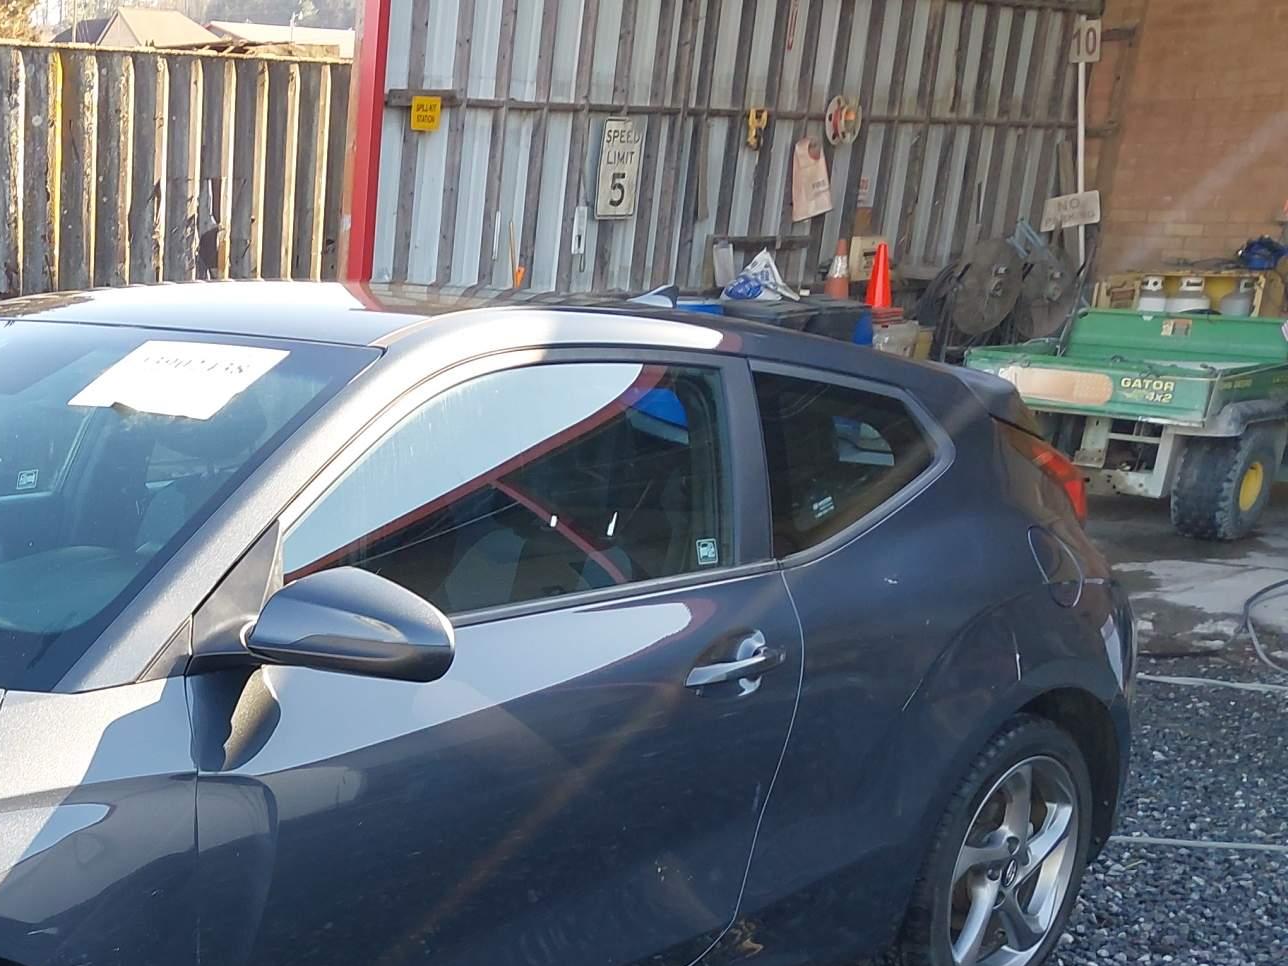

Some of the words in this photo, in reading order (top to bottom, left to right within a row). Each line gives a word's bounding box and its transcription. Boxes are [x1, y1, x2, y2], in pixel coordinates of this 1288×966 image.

[1073, 27, 1097, 57] 10
[605, 129, 641, 144] SPEED
[606, 151, 635, 165] LIMIT
[608, 172, 626, 207] 5
[1057, 198, 1081, 212] NO
[1120, 377, 1175, 392] GATOR
[1145, 393, 1173, 404] 4x2
